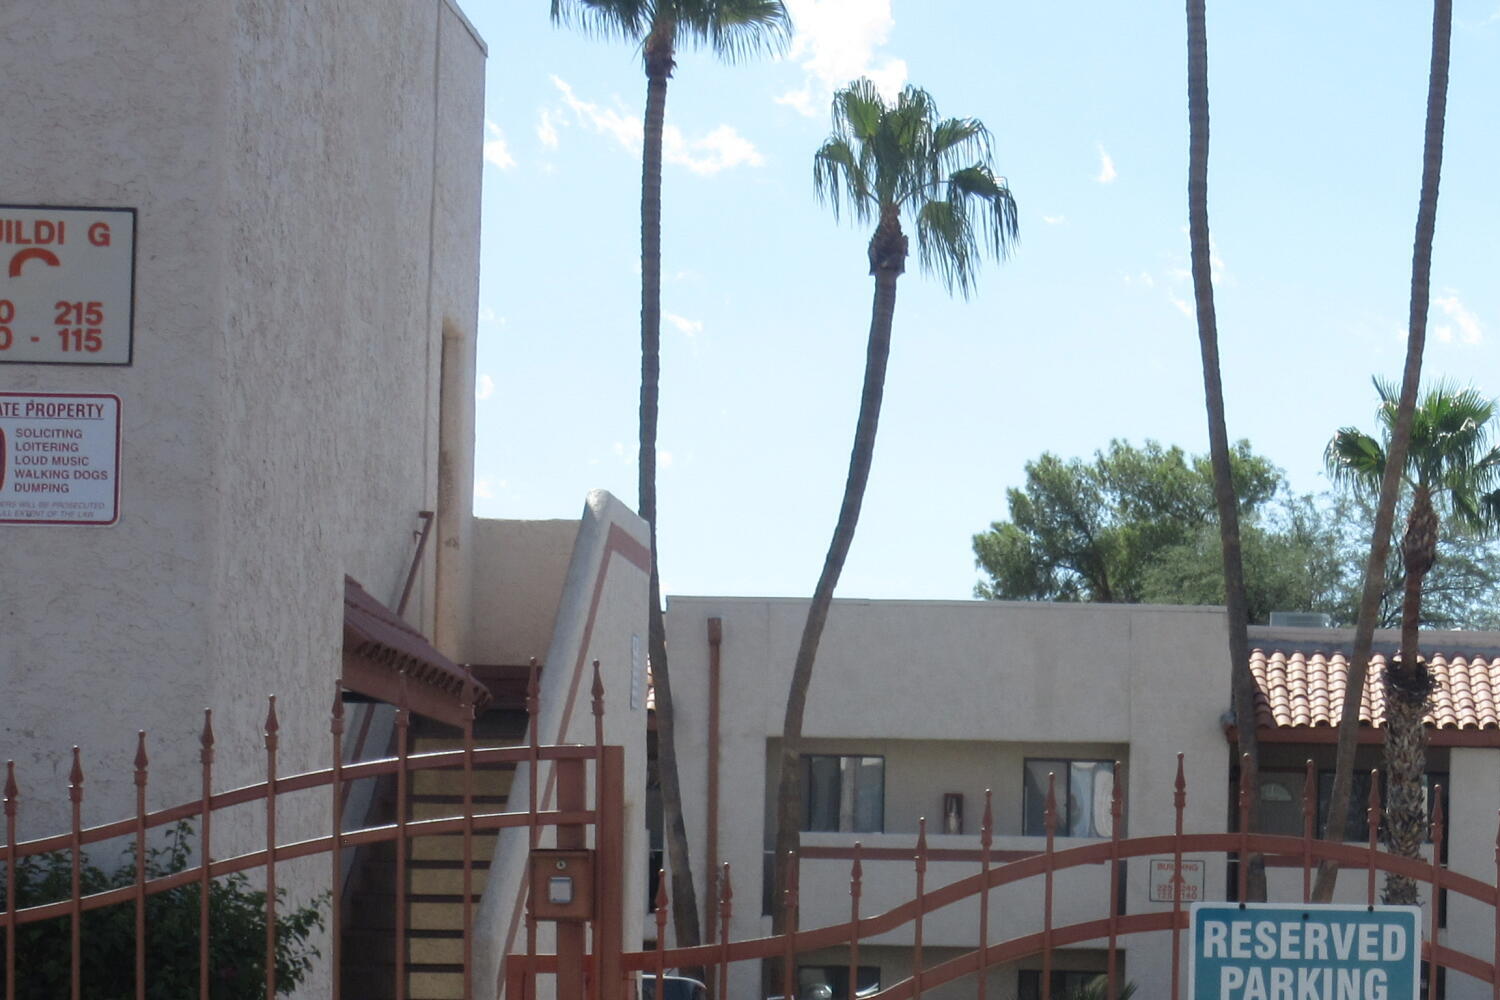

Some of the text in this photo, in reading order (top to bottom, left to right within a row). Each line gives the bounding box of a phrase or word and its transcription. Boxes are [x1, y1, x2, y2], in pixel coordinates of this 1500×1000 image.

[54, 301, 104, 326] 215
[58, 328, 102, 353] 115
[26, 402, 104, 418] PROPERTY
[15, 428, 82, 439] SOLICITING
[15, 442, 79, 452] LOITERING
[15, 455, 90, 467] LOUD MUSIC
[14, 469, 109, 480] WALKING DOGS
[14, 483, 69, 493] DUMPING
[1203, 920, 1407, 962] RESERVED
